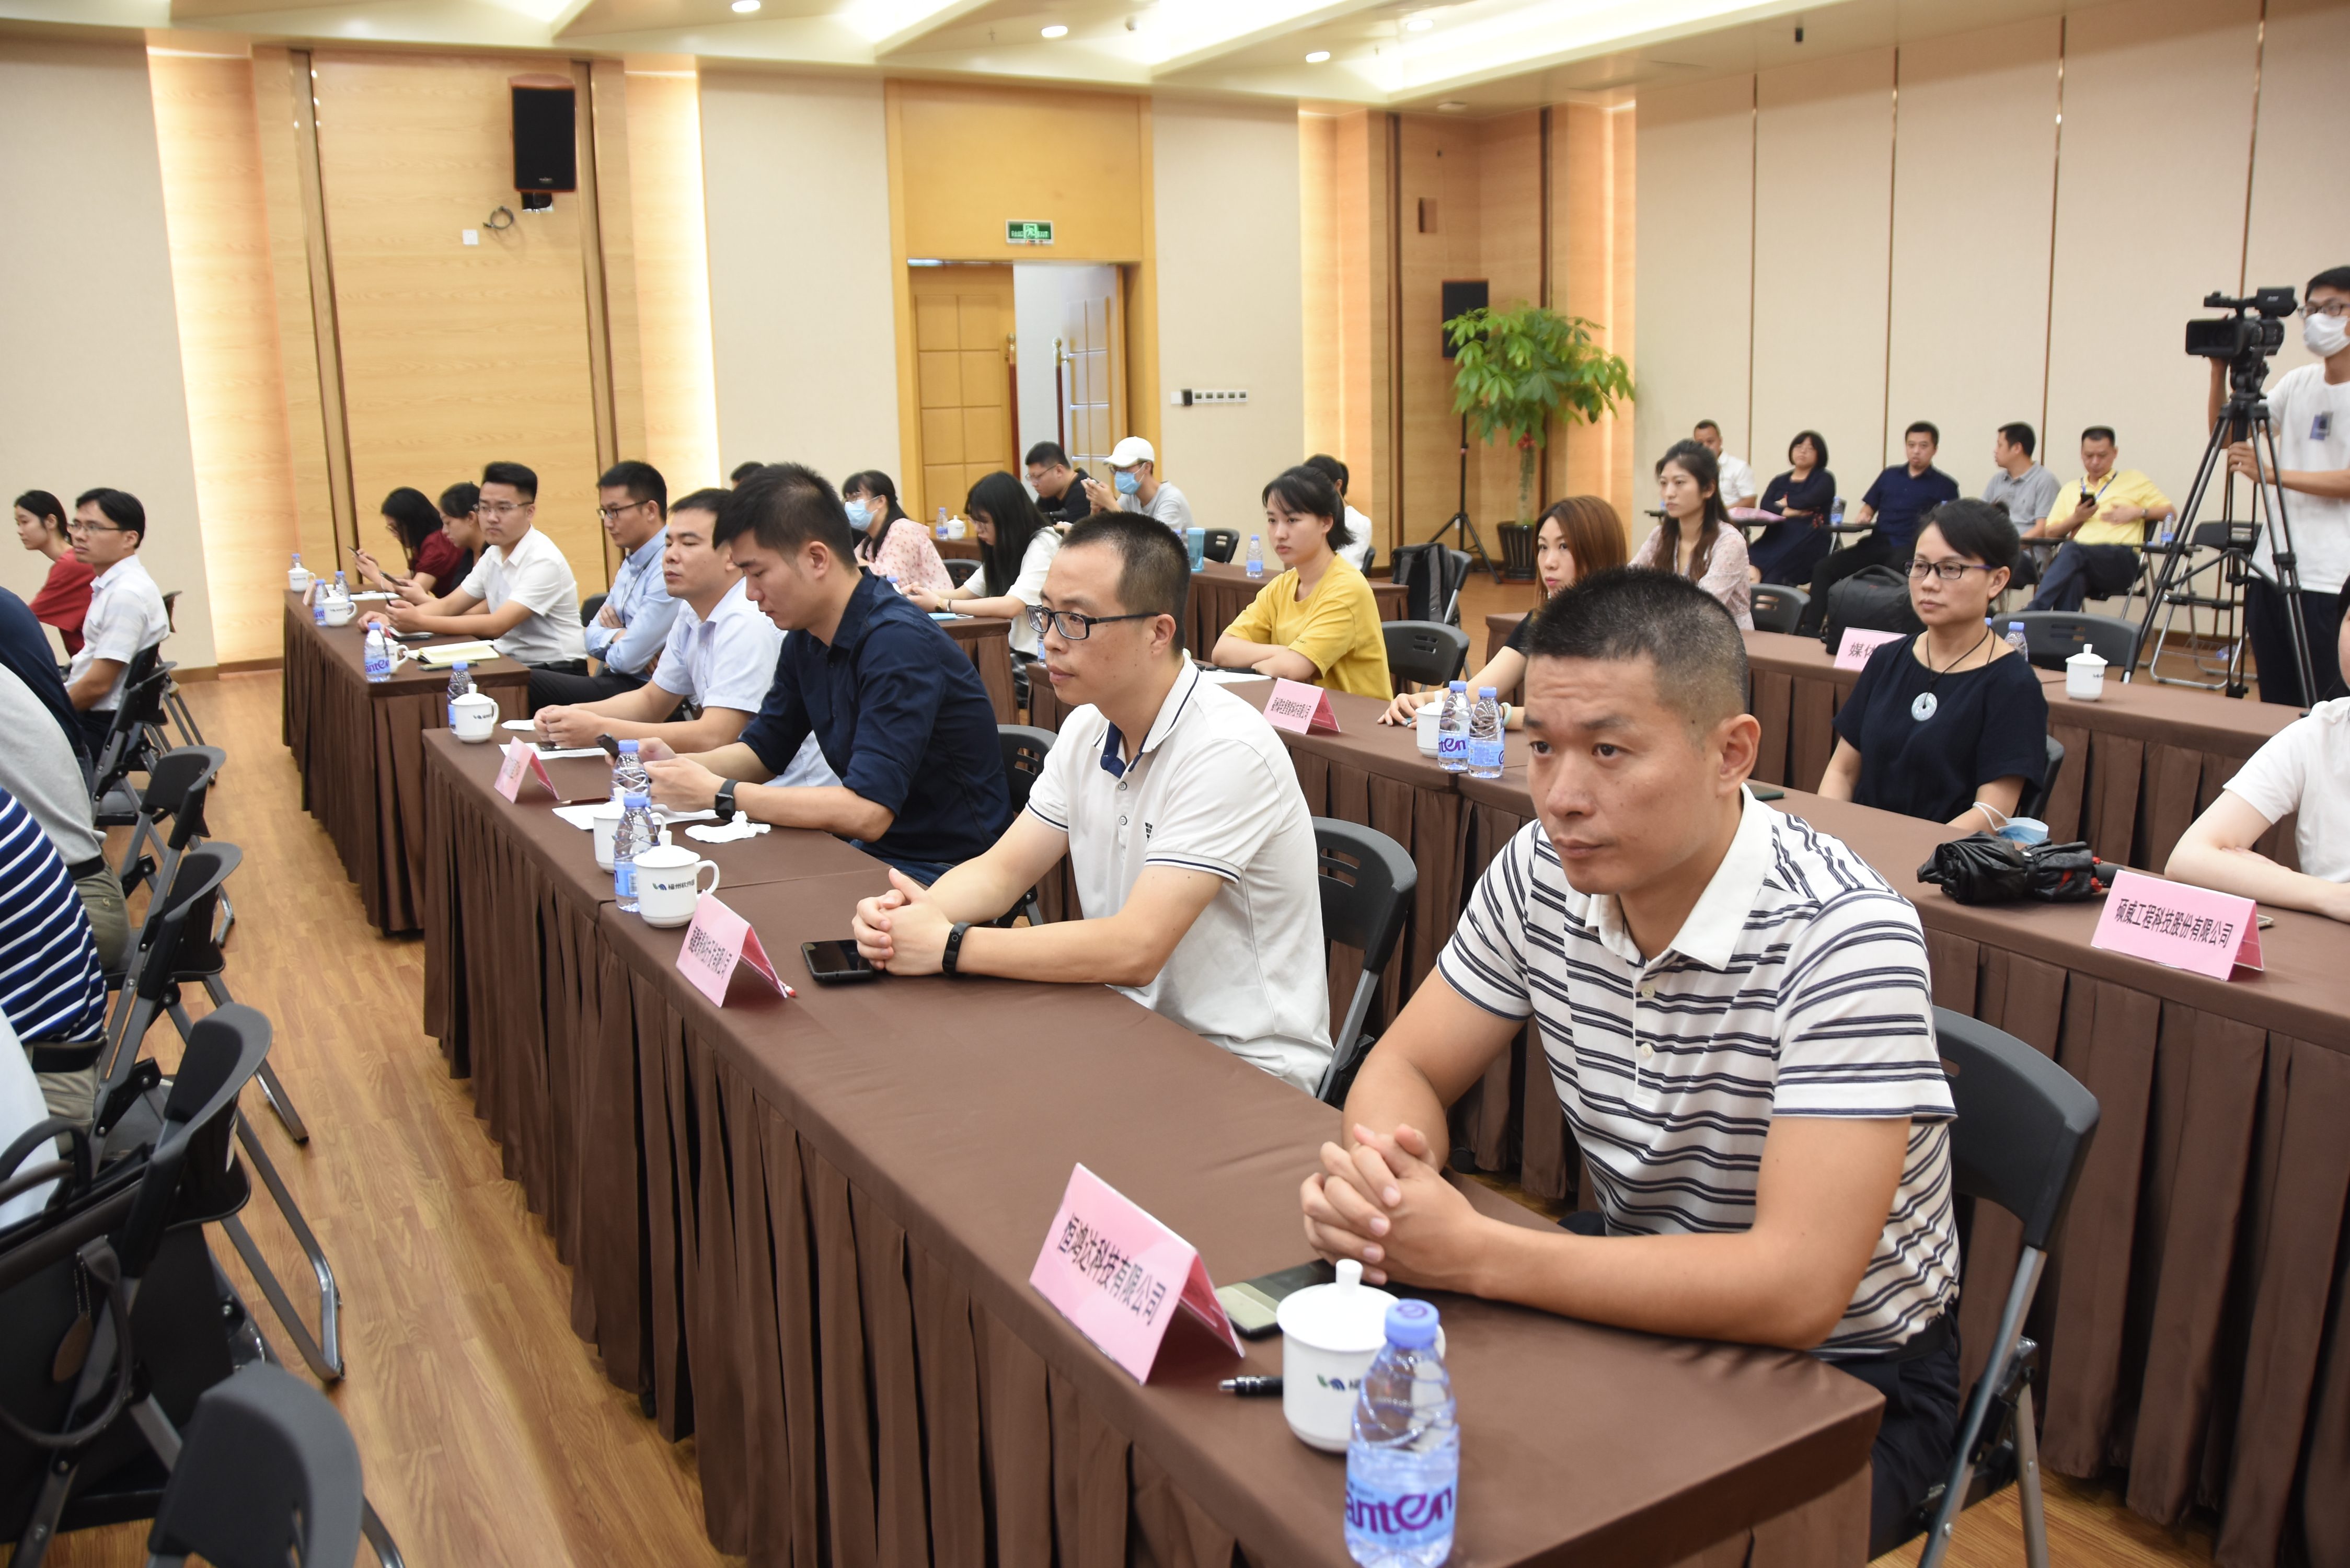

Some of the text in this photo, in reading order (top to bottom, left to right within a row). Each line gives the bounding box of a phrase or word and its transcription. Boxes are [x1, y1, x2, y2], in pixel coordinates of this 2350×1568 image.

[2115, 898, 2233, 949] 硕威工程科技股份有限公司
[1057, 1212, 1166, 1327] 恒鸿达科技有限公司
